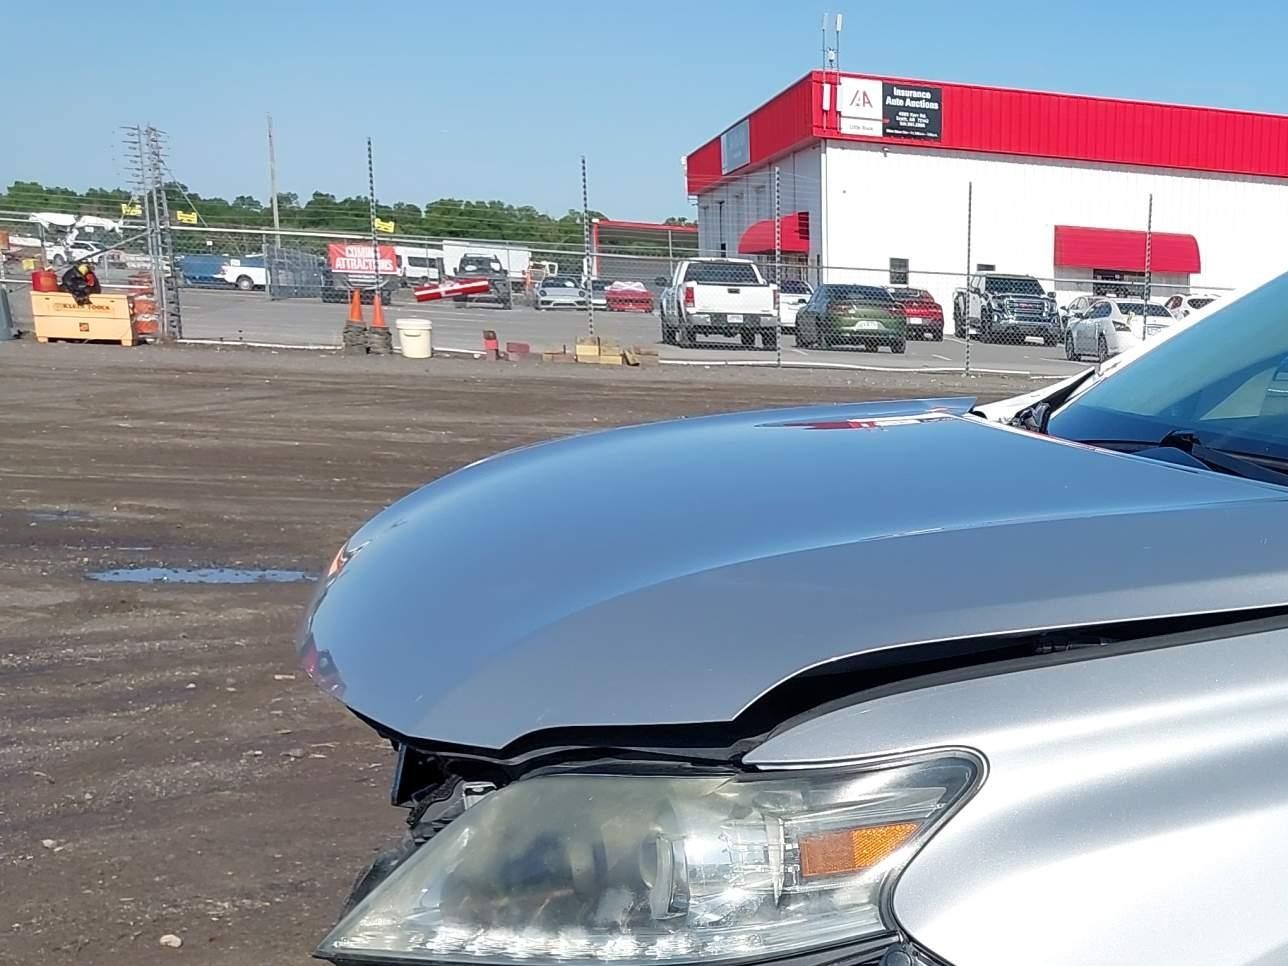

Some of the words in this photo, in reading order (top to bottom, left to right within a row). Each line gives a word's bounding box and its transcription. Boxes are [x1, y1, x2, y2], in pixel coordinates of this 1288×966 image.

[893, 87, 931, 99] Insurance
[885, 96, 904, 106] Auto
[905, 98, 939, 110] Auctions
